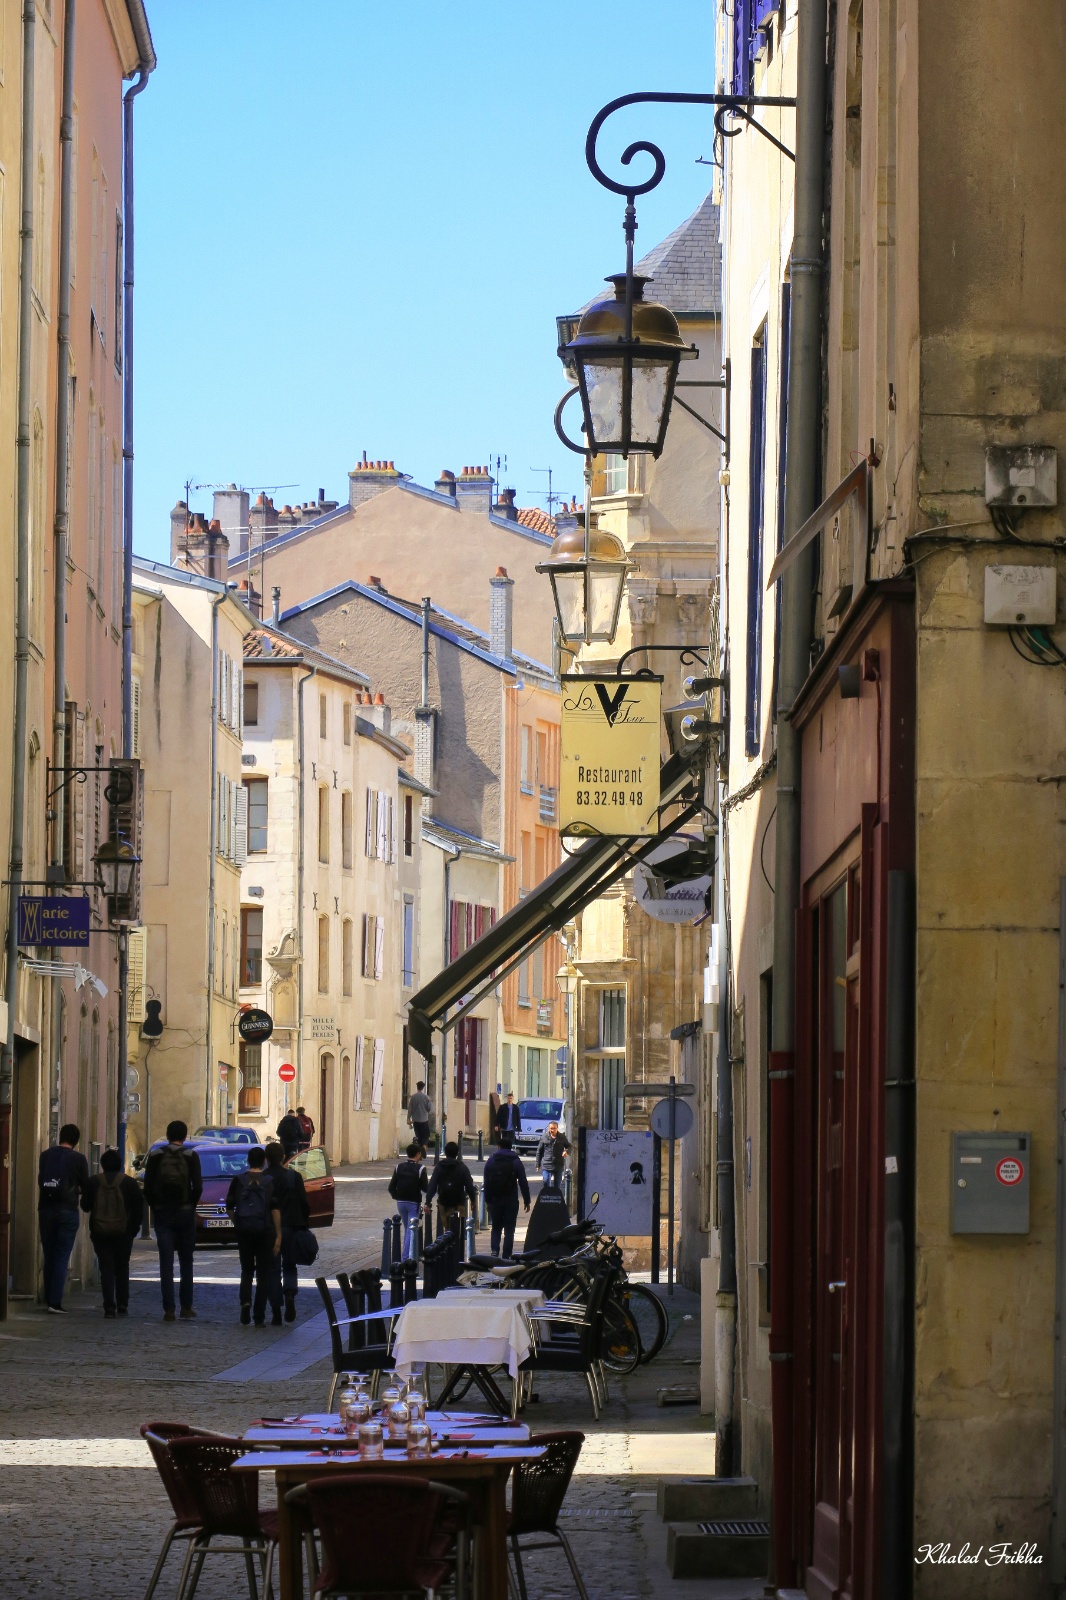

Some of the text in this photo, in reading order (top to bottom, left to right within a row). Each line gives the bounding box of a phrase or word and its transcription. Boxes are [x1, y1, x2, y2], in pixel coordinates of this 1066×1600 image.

[578, 766, 642, 783] Restaurant
[576, 791, 643, 806] 83.32.49.48
[241, 1021, 270, 1031] GUINNESS
